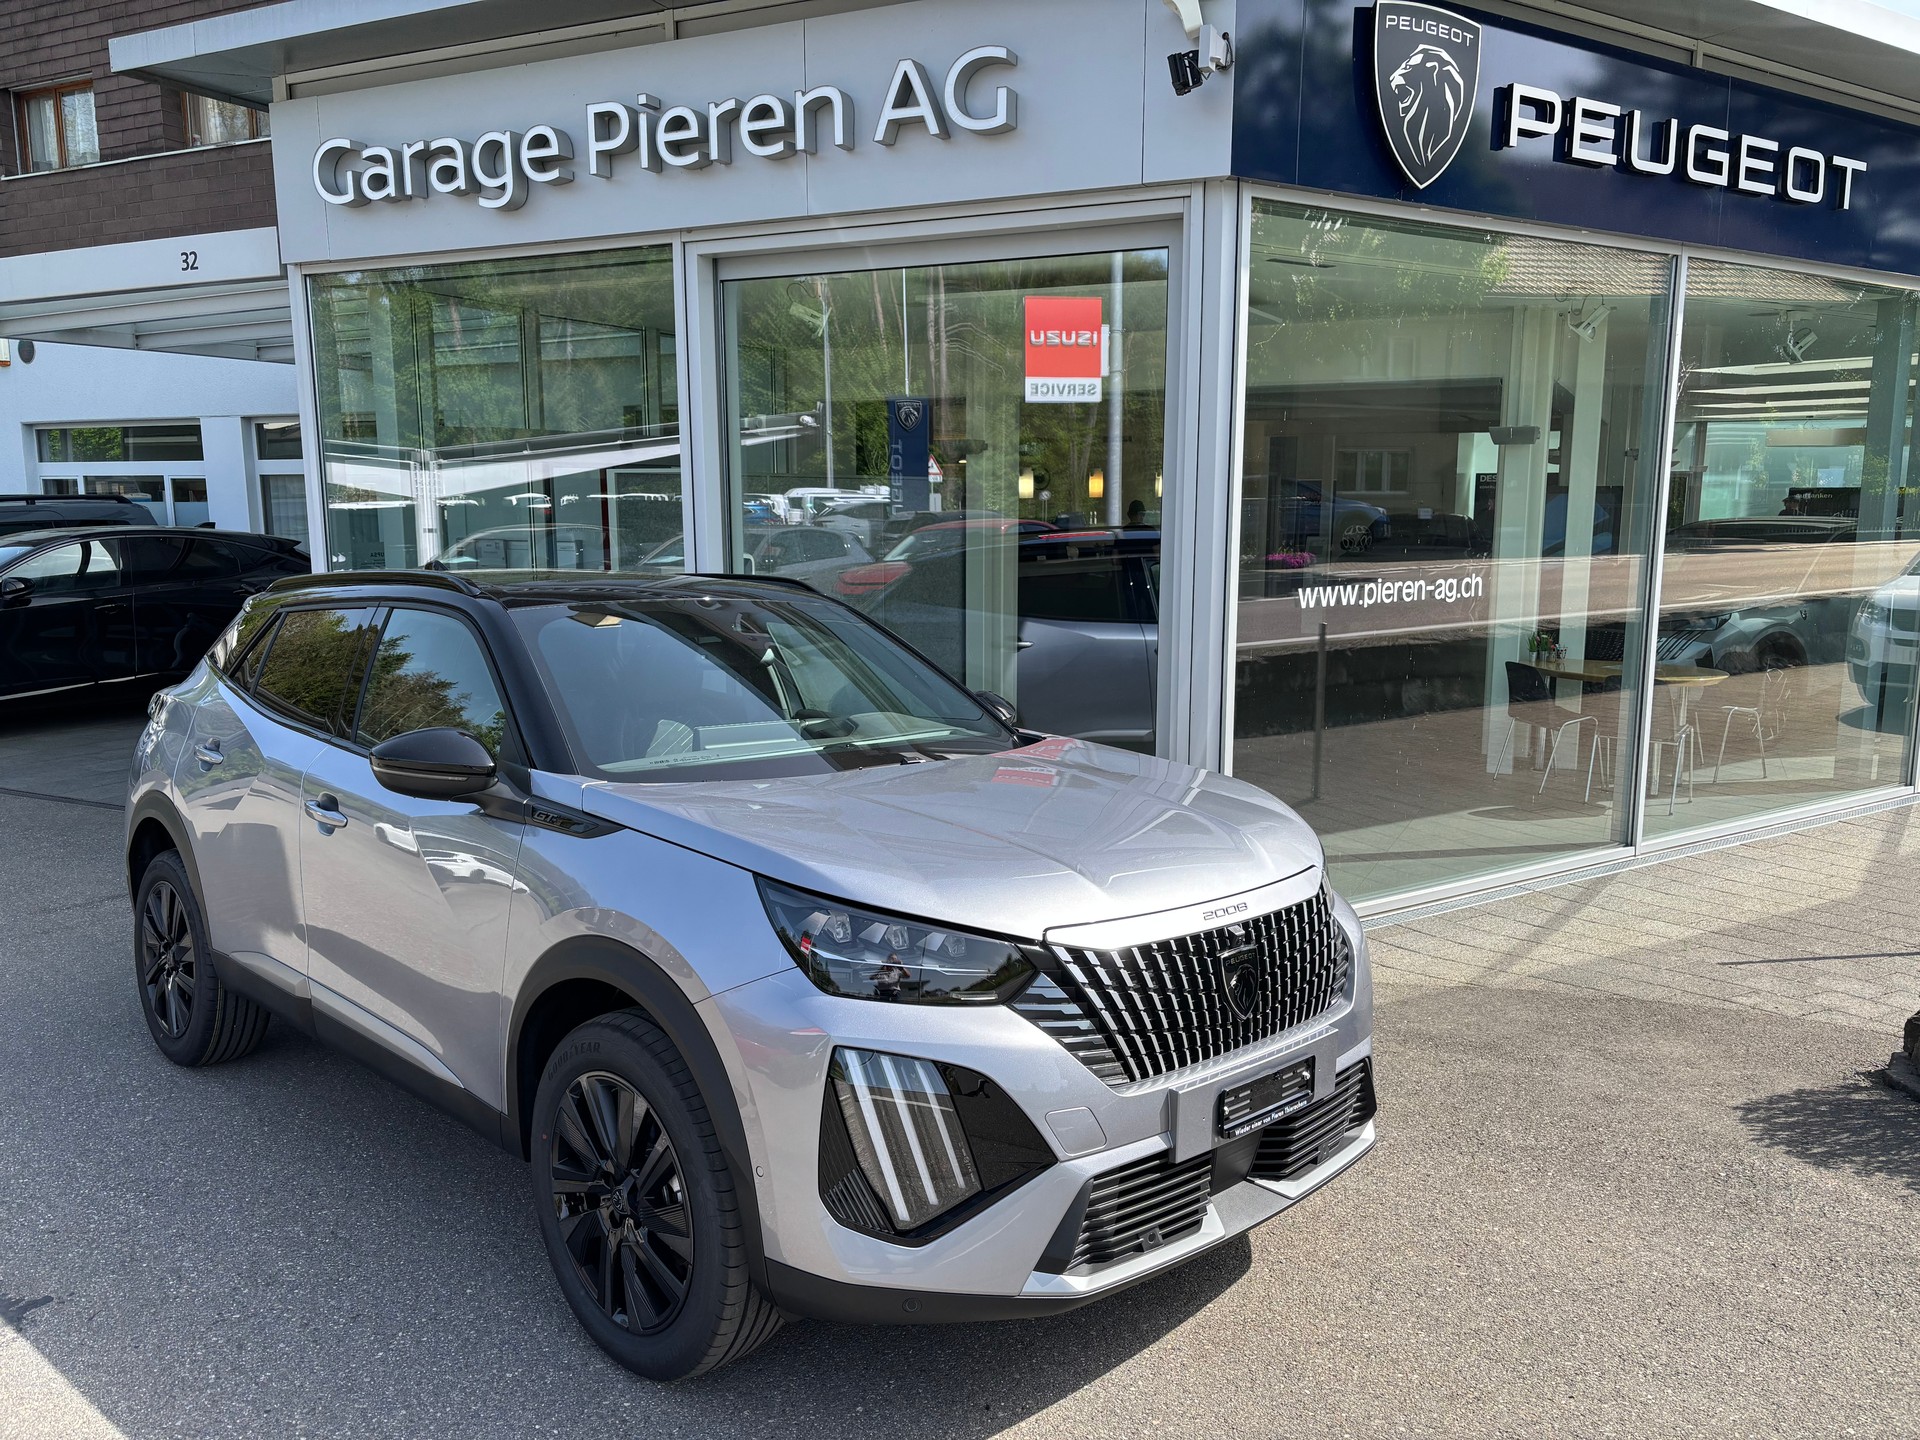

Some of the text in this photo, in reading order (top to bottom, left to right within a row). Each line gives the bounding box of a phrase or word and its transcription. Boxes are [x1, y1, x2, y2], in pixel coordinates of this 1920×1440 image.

[1385, 14, 1474, 47] PEUGEOT
[312, 45, 1017, 211] Garage Pieren AG
[1507, 82, 1868, 210] PEUGEOT
[180, 251, 199, 271] 32
[1298, 573, 1482, 609] www.pieren-ag.ch
[533, 810, 558, 823] GT
[1203, 902, 1248, 921] 2008
[1225, 952, 1256, 967] PEUGEOT
[547, 1041, 601, 1080] GOODYEAR
[1234, 1125, 1251, 1136] Wieder
[1263, 1116, 1271, 1124] von
[1271, 1110, 1284, 1120] Pieren
